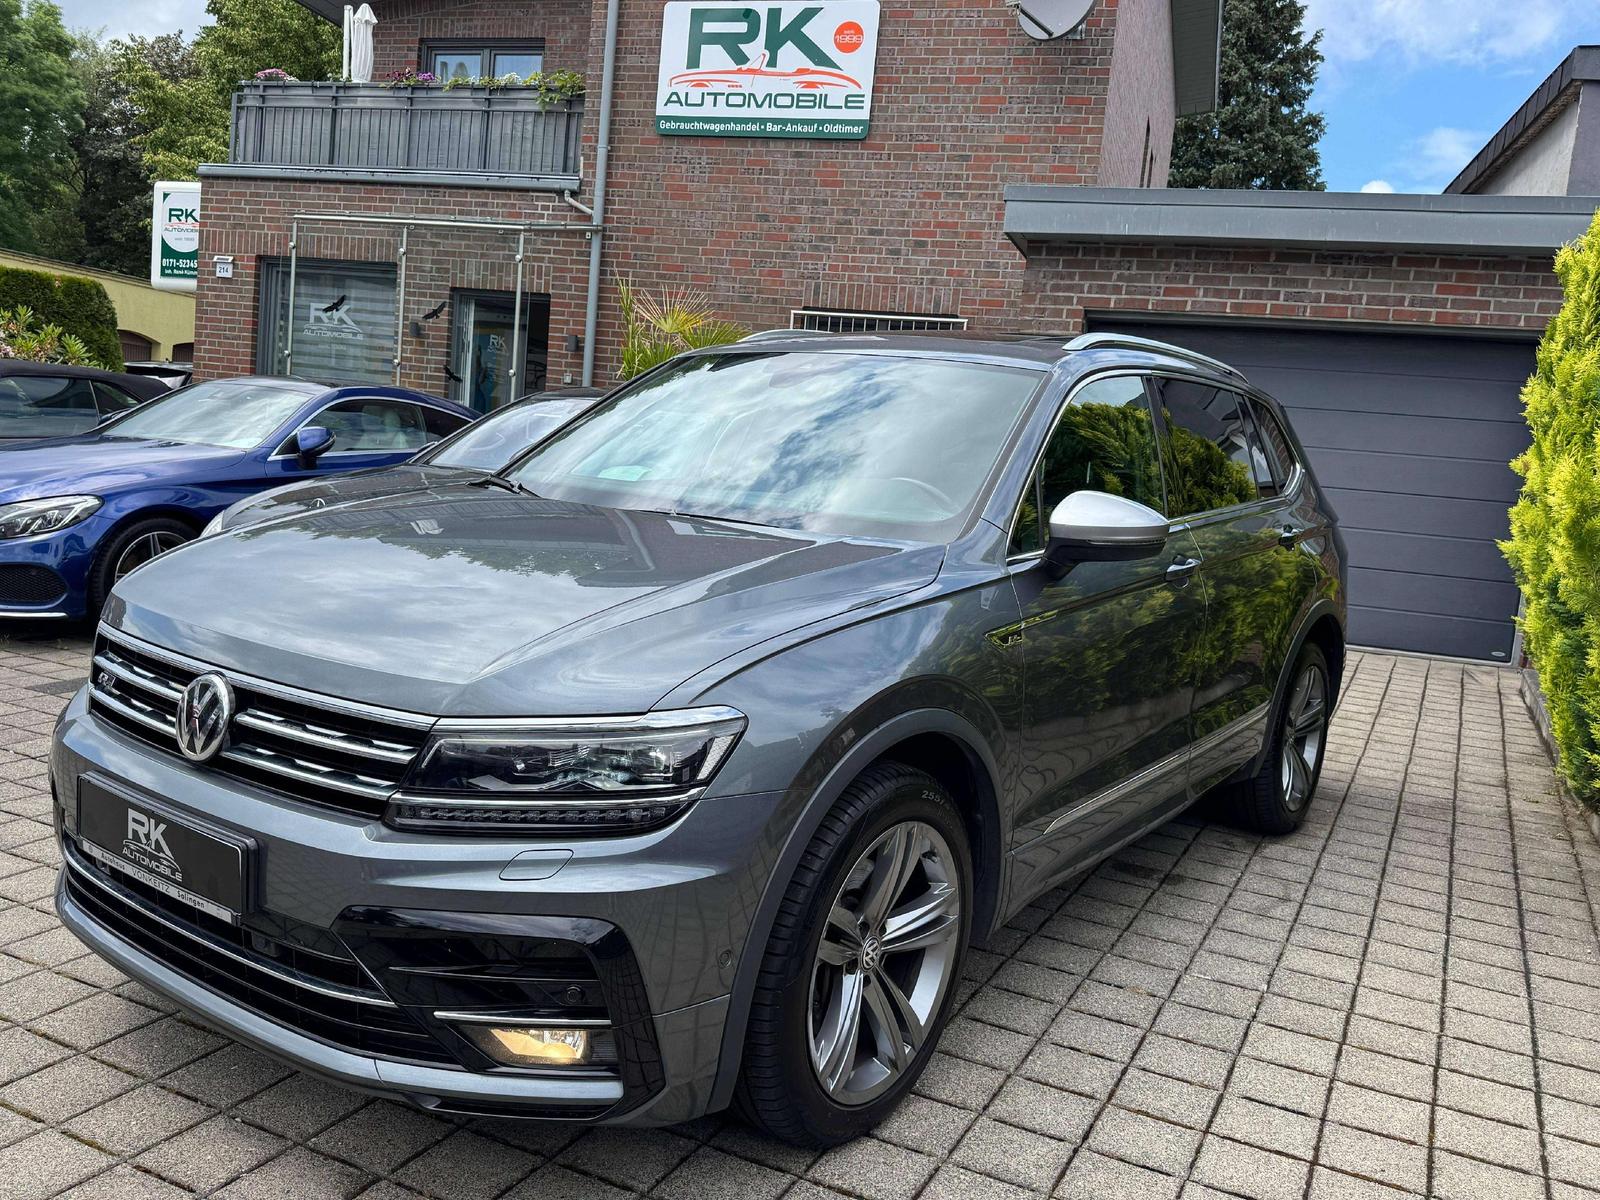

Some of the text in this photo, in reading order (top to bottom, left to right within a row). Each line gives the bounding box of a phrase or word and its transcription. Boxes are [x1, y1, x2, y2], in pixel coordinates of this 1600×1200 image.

[686, 7, 844, 71] RK
[834, 34, 863, 43] 1999
[663, 91, 866, 110] AUTOMOBILE
[659, 119, 864, 134] Gebrauchtwagenhandel Bar-Ankauf Oldtimer
[168, 208, 200, 222] RK
[310, 302, 357, 327] RK
[489, 334, 508, 350] RK
[127, 807, 175, 860] RK
[122, 846, 183, 882] AUTOMOBILE
[177, 889, 205, 908] Solingen
